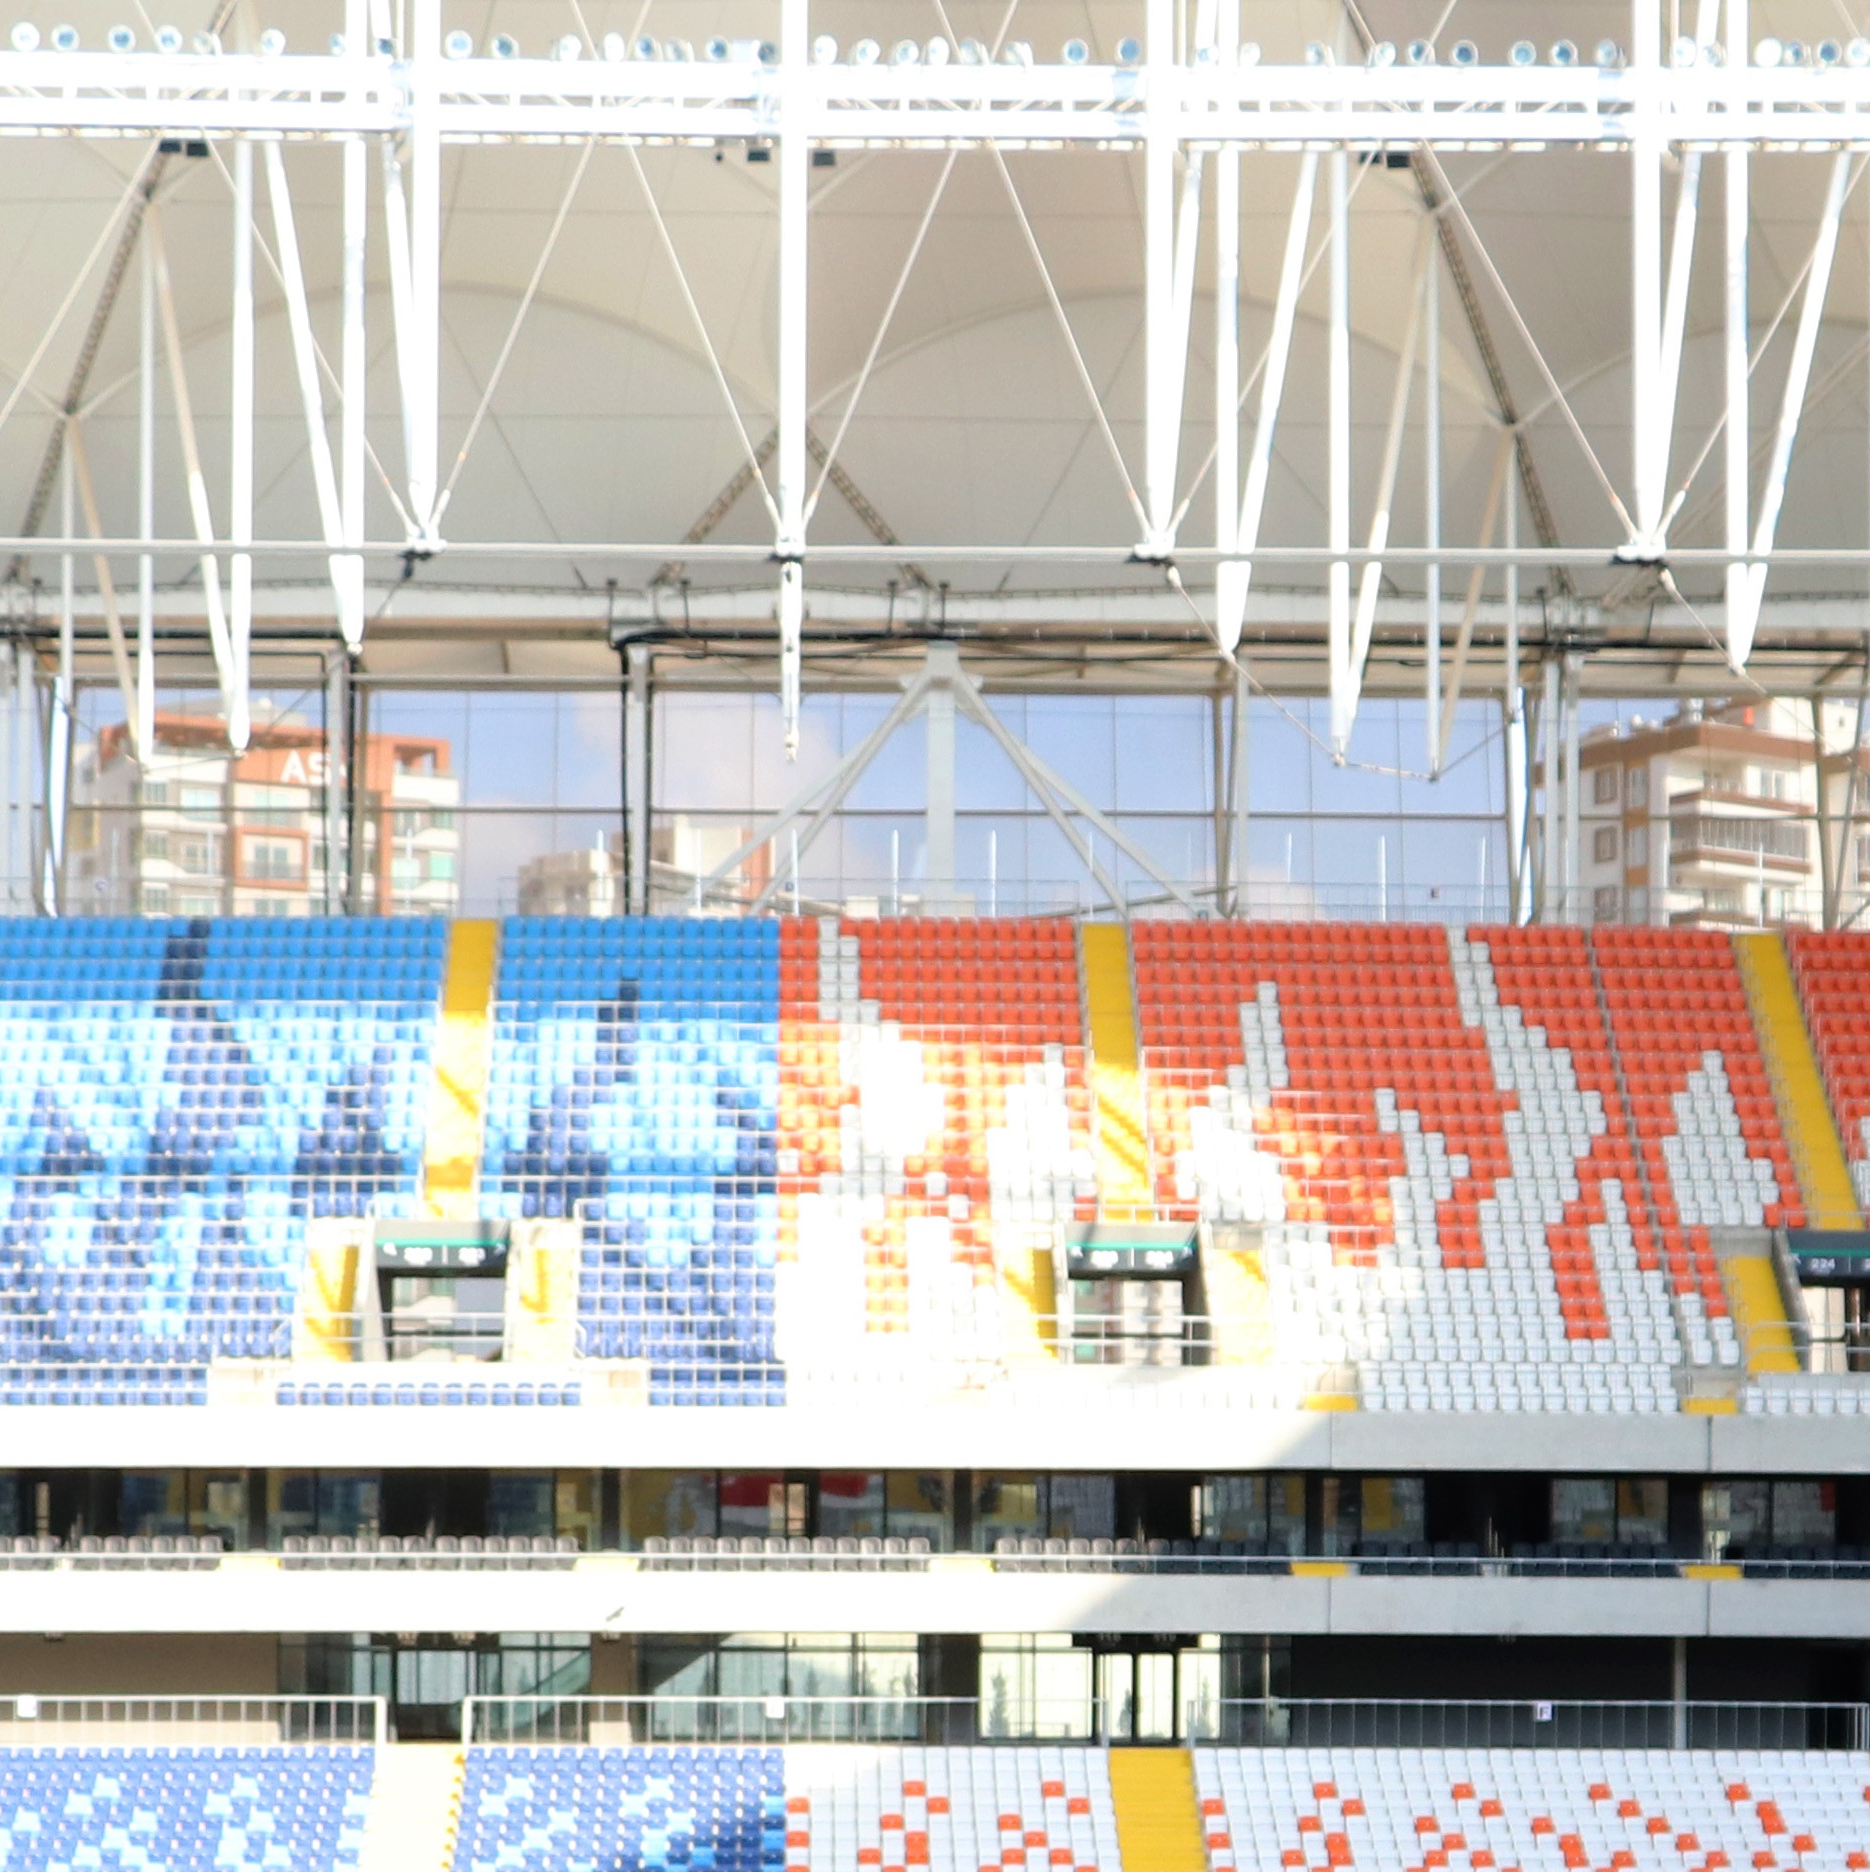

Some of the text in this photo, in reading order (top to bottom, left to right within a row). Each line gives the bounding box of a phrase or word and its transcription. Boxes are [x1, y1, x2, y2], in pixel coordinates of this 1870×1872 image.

[280, 750, 348, 787] AS
[1810, 1258, 1836, 1270] 224
[1539, 1705, 1549, 1718] F
